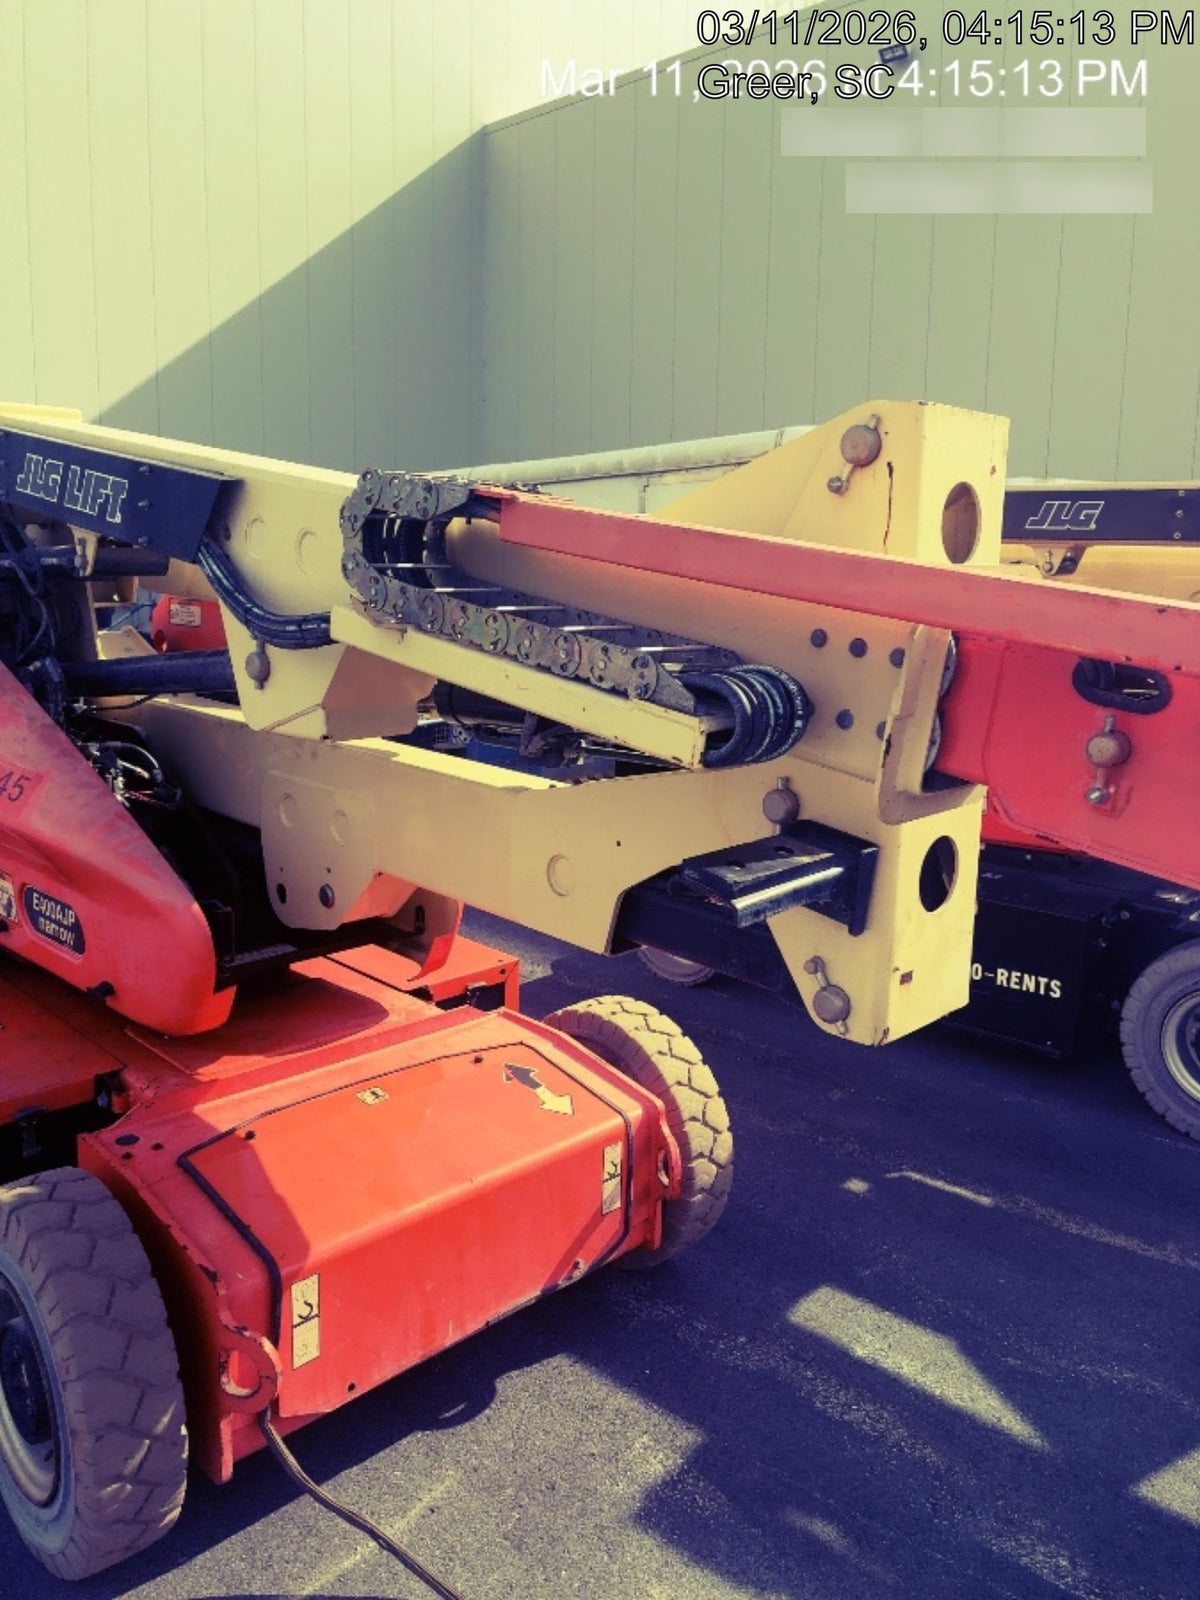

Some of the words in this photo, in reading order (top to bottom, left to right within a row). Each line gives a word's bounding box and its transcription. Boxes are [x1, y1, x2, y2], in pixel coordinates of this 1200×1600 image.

[16, 452, 64, 502] JLG
[64, 465, 128, 523] LIFT
[1025, 500, 1105, 531] JLG
